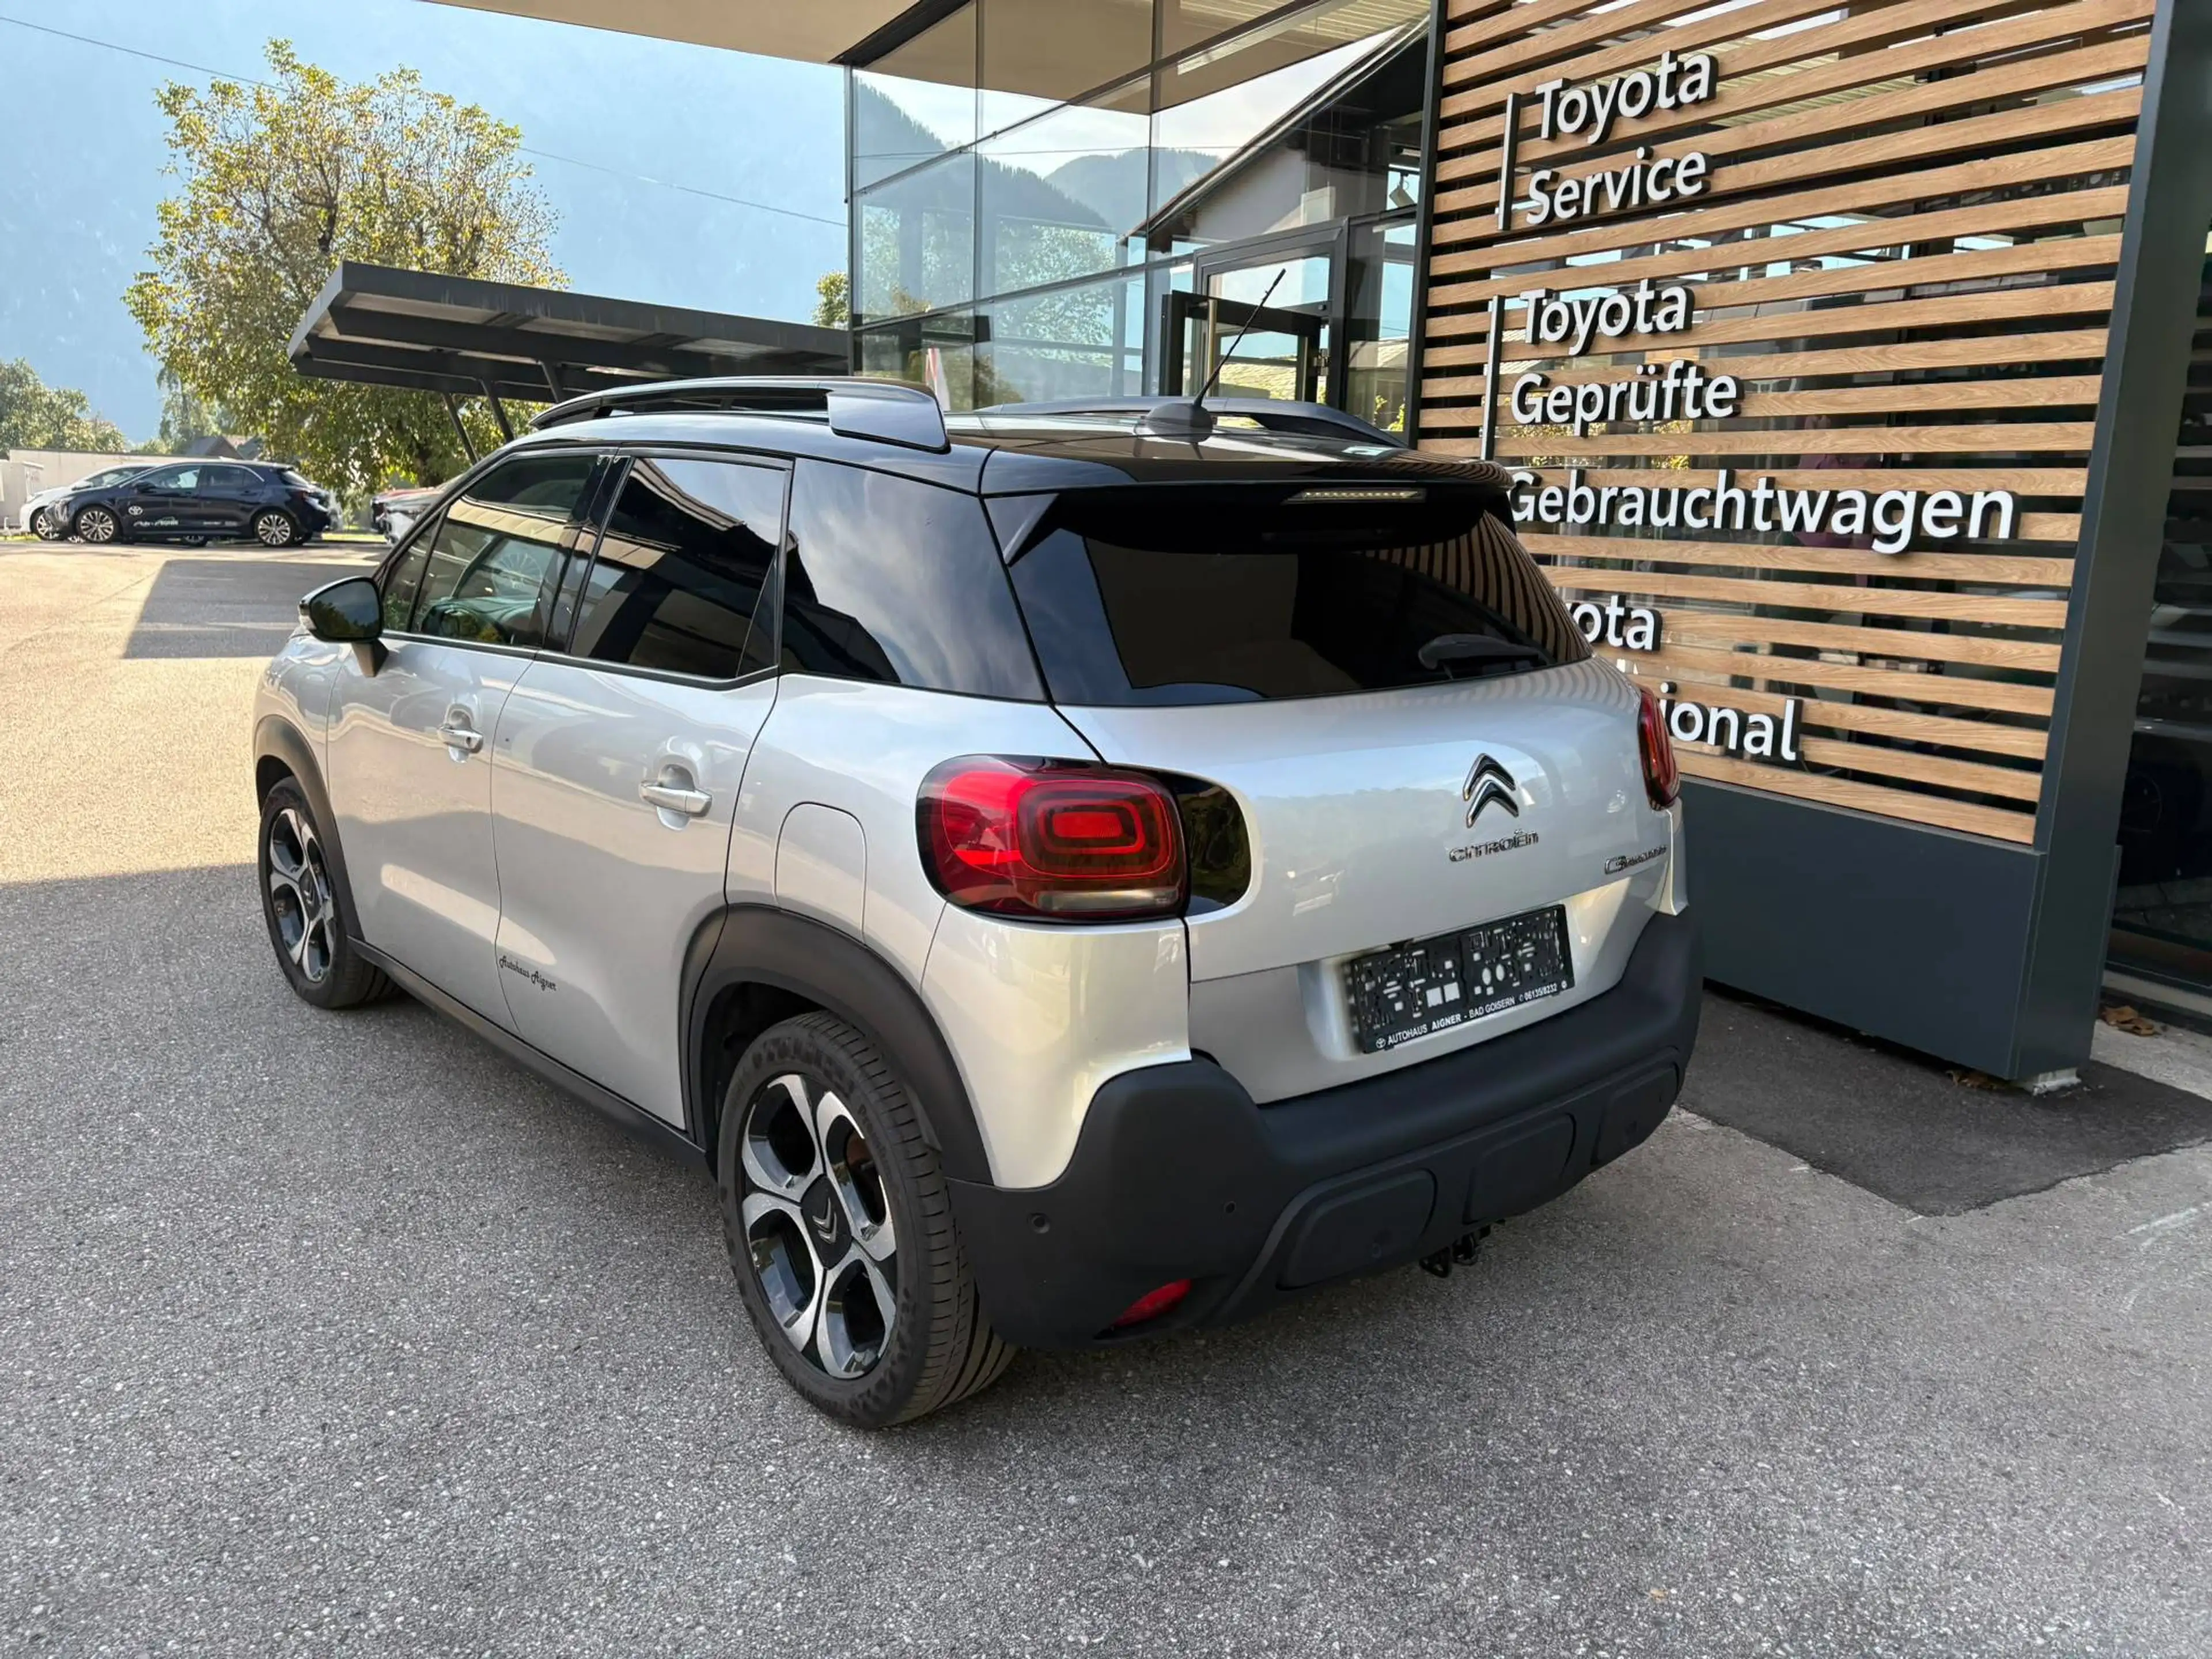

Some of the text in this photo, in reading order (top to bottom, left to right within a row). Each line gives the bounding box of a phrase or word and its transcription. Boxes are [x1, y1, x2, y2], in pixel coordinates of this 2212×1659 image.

[1535, 50, 1714, 144] Toyota
[1527, 146, 1710, 225] Service
[1520, 279, 1691, 356] Toyota
[1511, 359, 1740, 437] Geprüfte
[1508, 469, 2015, 555] Gebrauchtwagen
[1566, 595, 1658, 651] ota
[1660, 682, 1799, 762] ional
[1449, 829, 1539, 862] CITROËN
[1387, 1024, 1427, 1046] AUTOHAUS
[1431, 1013, 1461, 1031] AIGNER
[1469, 1006, 1484, 1018] BAD
[1485, 996, 1516, 1013] GOISERN
